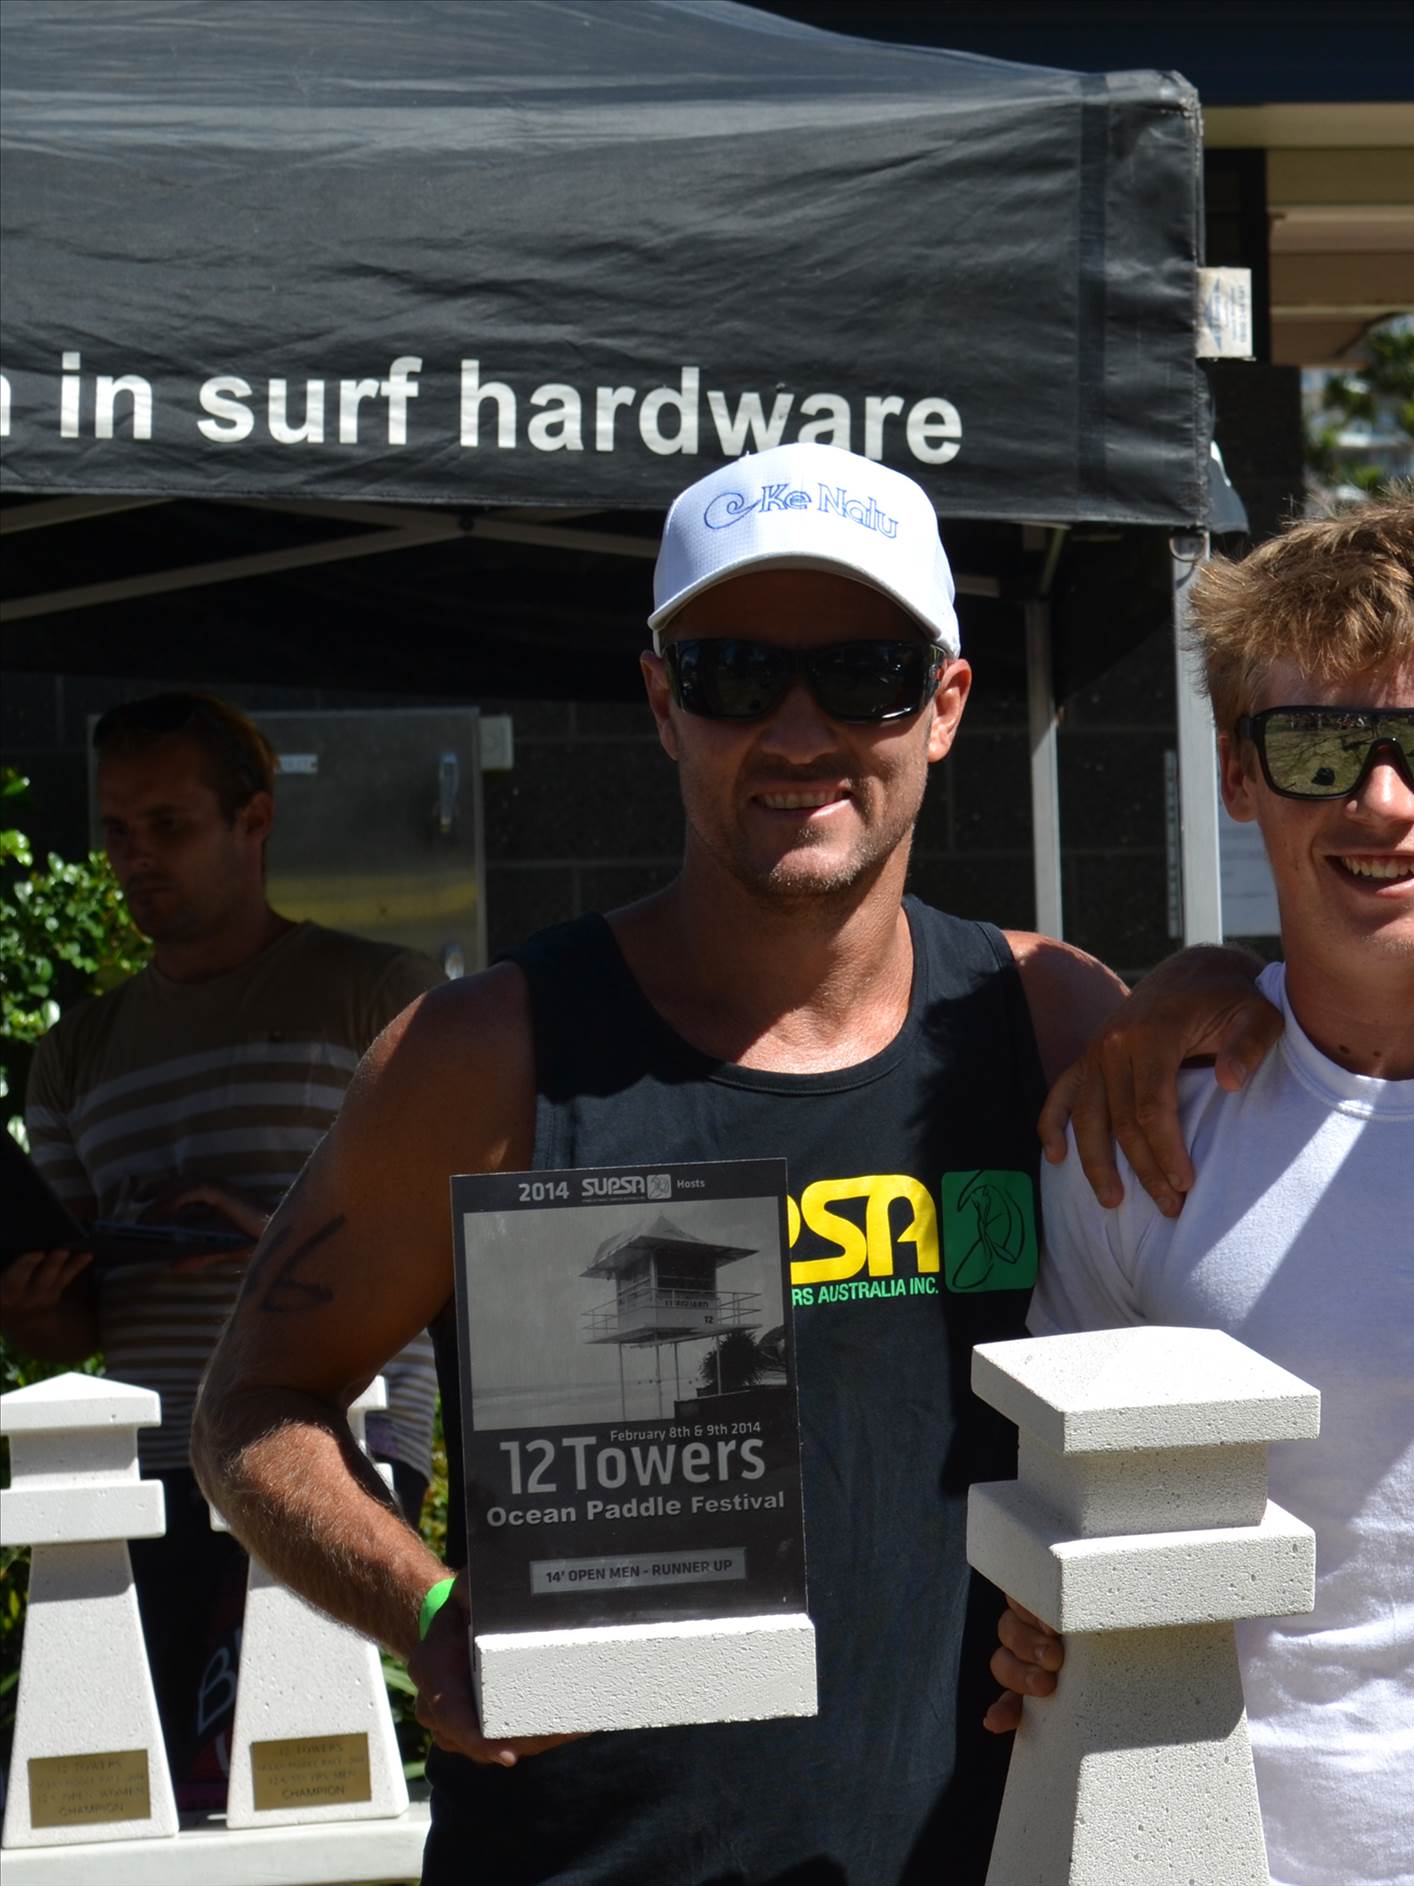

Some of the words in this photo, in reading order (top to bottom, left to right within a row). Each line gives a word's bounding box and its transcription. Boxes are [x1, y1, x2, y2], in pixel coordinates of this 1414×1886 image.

[60, 351, 152, 439] in
[197, 356, 423, 445] surf
[460, 359, 963, 465] hardware
[518, 1181, 570, 1202] 2014
[677, 1178, 705, 1189] Hosts
[787, 1174, 940, 1284] SA
[818, 1278, 906, 1304] AUSTRALIA
[909, 1277, 939, 1295] INC.
[610, 1429, 667, 1442] February
[669, 1426, 691, 1438] 8th
[694, 1425, 703, 1436] &
[707, 1424, 728, 1436] 9th
[731, 1422, 761, 1434] 2014
[487, 1505, 577, 1527] Ocean
[587, 1497, 681, 1521] Paddle
[692, 1491, 785, 1514] Festival
[568, 1568, 605, 1582] OPEN
[609, 1565, 640, 1579] MEN
[652, 1561, 710, 1576] RUNNER
[714, 1559, 733, 1572] UP
